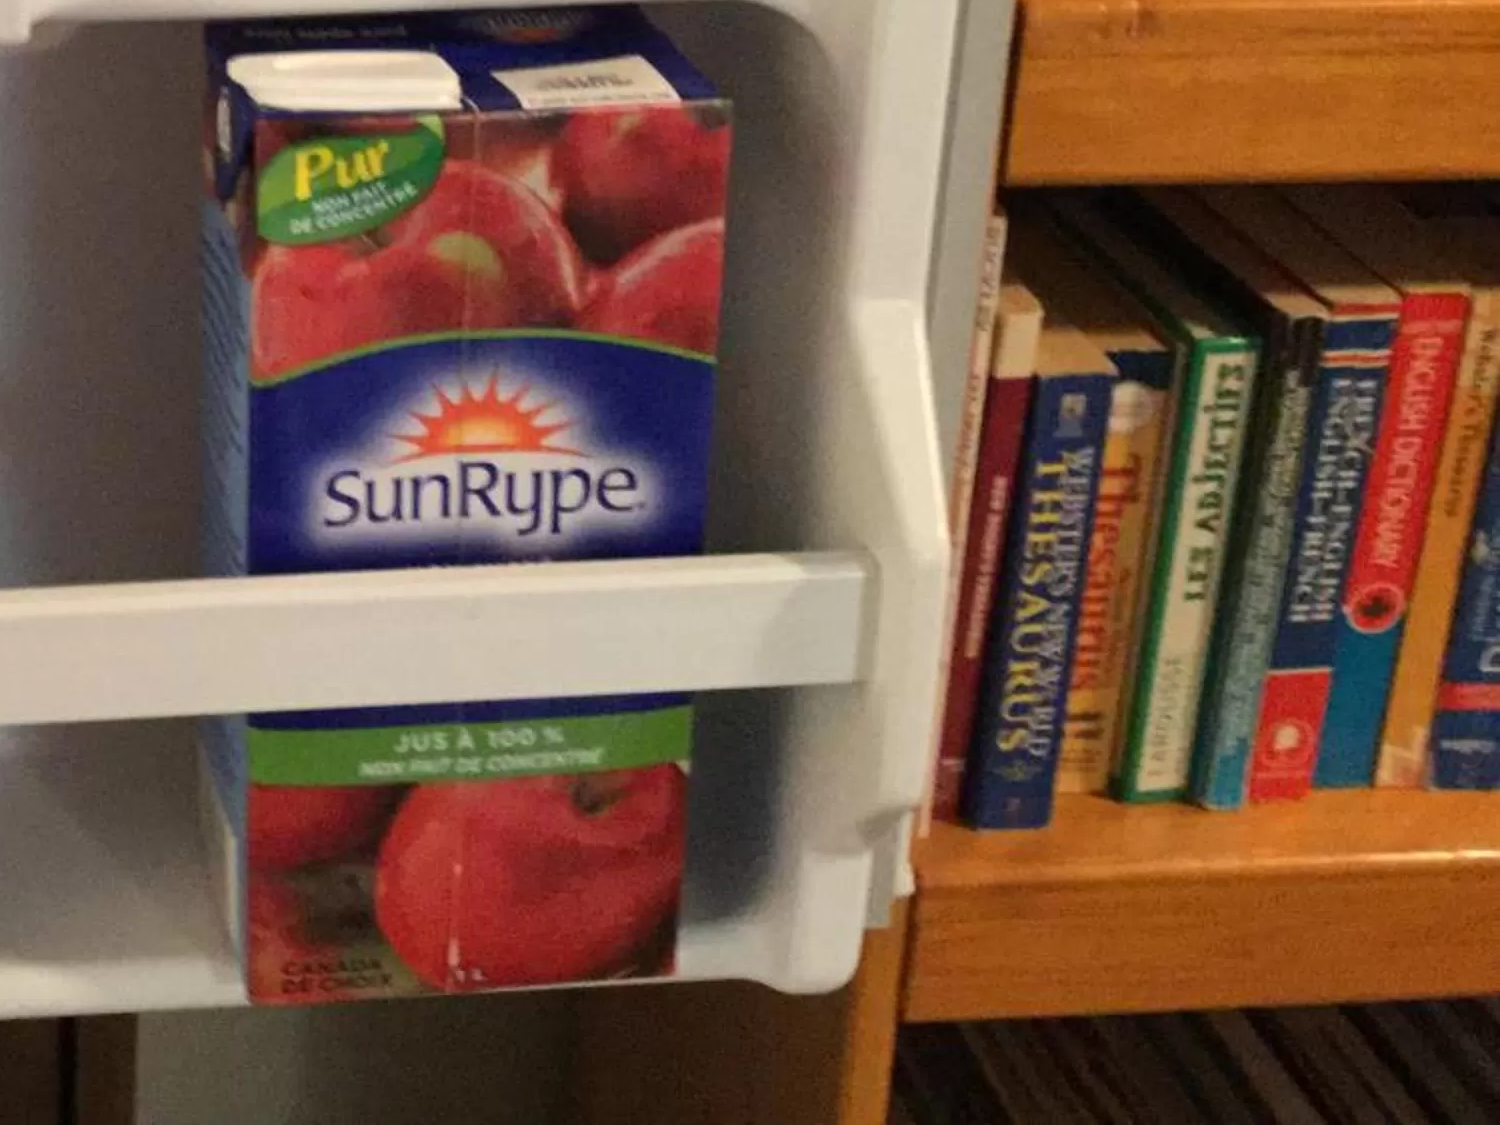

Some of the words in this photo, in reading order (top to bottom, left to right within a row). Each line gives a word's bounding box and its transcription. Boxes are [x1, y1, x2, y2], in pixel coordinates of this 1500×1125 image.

[294, 139, 390, 202] Pur
[1398, 337, 1445, 431] ENGLISH
[323, 460, 637, 536] SunRype
[1370, 435, 1422, 570] DICTIONARY
[996, 461, 1068, 753] THESAURUS
[394, 731, 450, 753] JUS
[456, 726, 477, 751] À
[487, 727, 538, 749] 100
[543, 726, 566, 744] %
